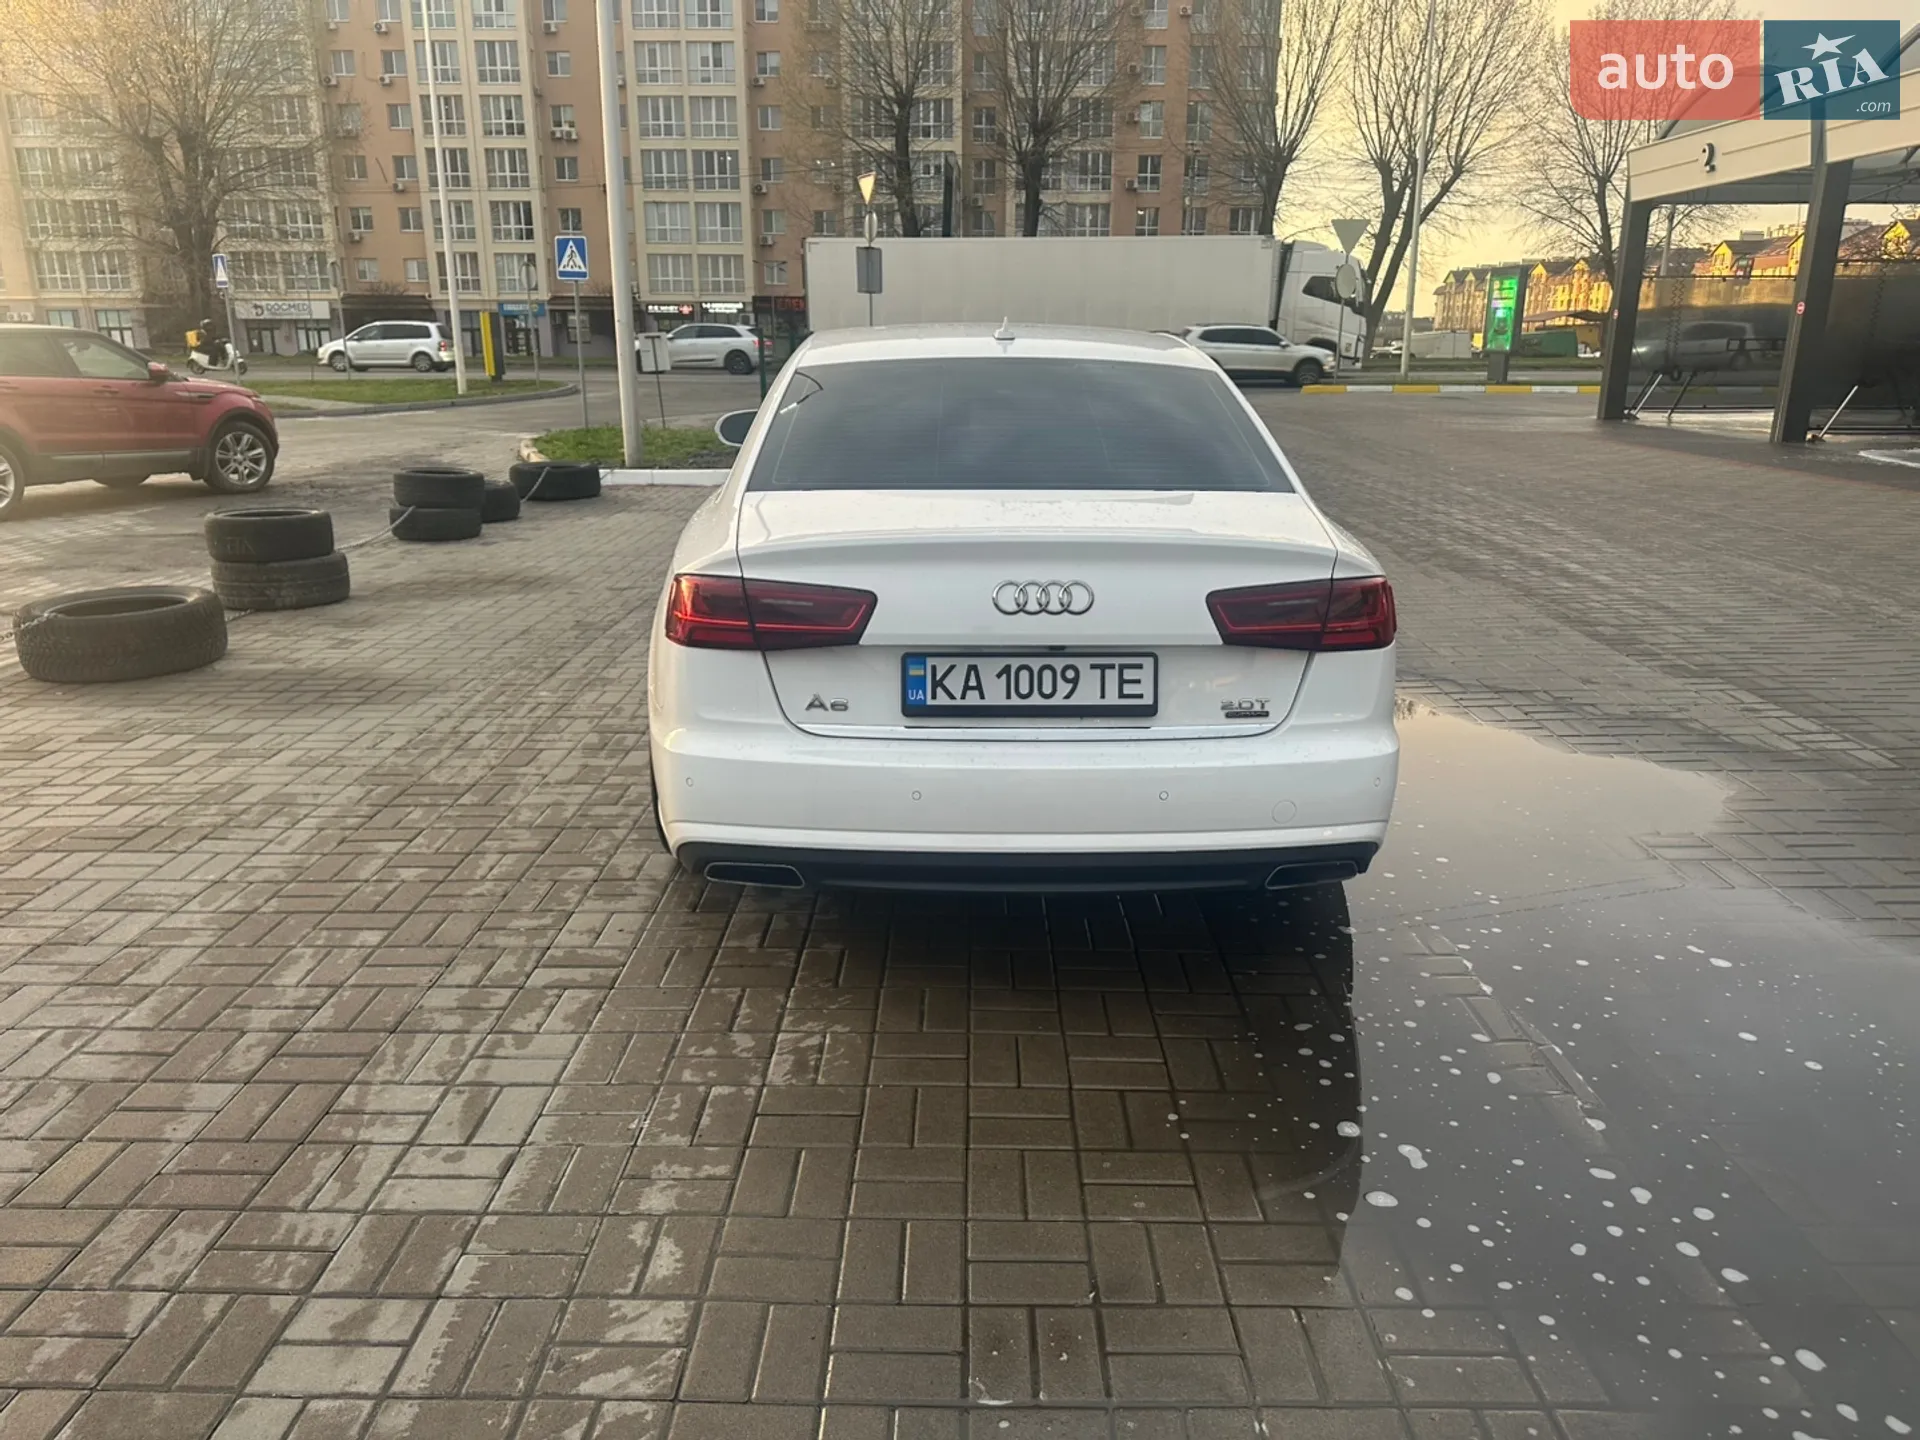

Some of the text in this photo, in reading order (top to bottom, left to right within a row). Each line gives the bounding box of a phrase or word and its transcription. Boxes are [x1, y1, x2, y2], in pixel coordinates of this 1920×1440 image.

[930, 663, 1145, 701] KA 1009 TE
[805, 694, 850, 712] A6
[908, 689, 925, 701] UA
[1220, 697, 1270, 711] 2.0T
